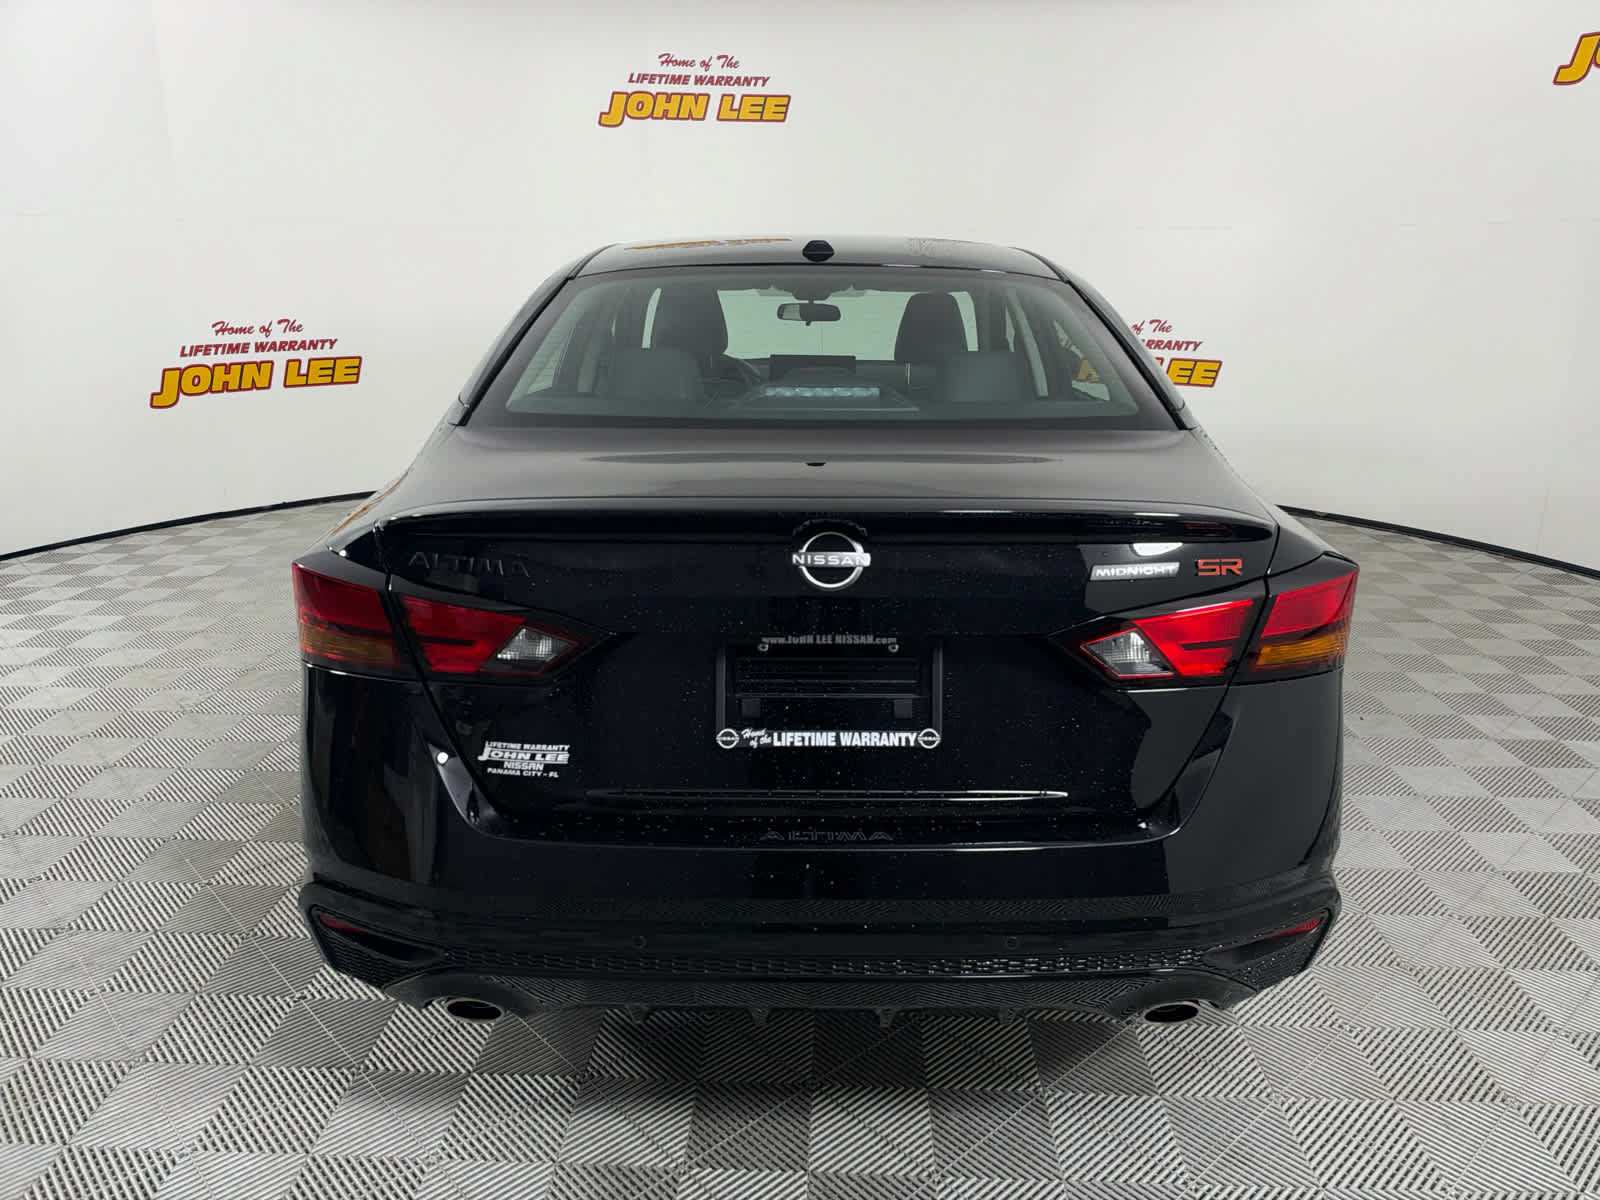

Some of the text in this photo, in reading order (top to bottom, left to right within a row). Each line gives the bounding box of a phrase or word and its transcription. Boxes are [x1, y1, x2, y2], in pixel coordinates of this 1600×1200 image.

[658, 53, 740, 71] Home of The
[628, 72, 770, 87] LIFETIME WARRANTY
[598, 91, 791, 128] JOHN LEE
[211, 318, 304, 337] Home of The
[1149, 318, 1173, 333] The
[180, 338, 338, 357] LIFETIME WARRANTY
[1142, 339, 1203, 351] RRANTY
[1155, 357, 1222, 388] EE
[150, 356, 362, 409] JOHN LEE
[792, 553, 867, 566] NISSAN
[1096, 558, 1243, 577] MIDNIGHT SR
[816, 634, 834, 645] LEE
[486, 741, 570, 751] LIFETIME WARRANTY
[773, 732, 836, 747] LIFETIME
[839, 732, 917, 747] WARRANTY
[478, 747, 570, 762] JOHN LEE
[487, 767, 520, 776] PANAMA
[503, 761, 544, 771] NISSAN
